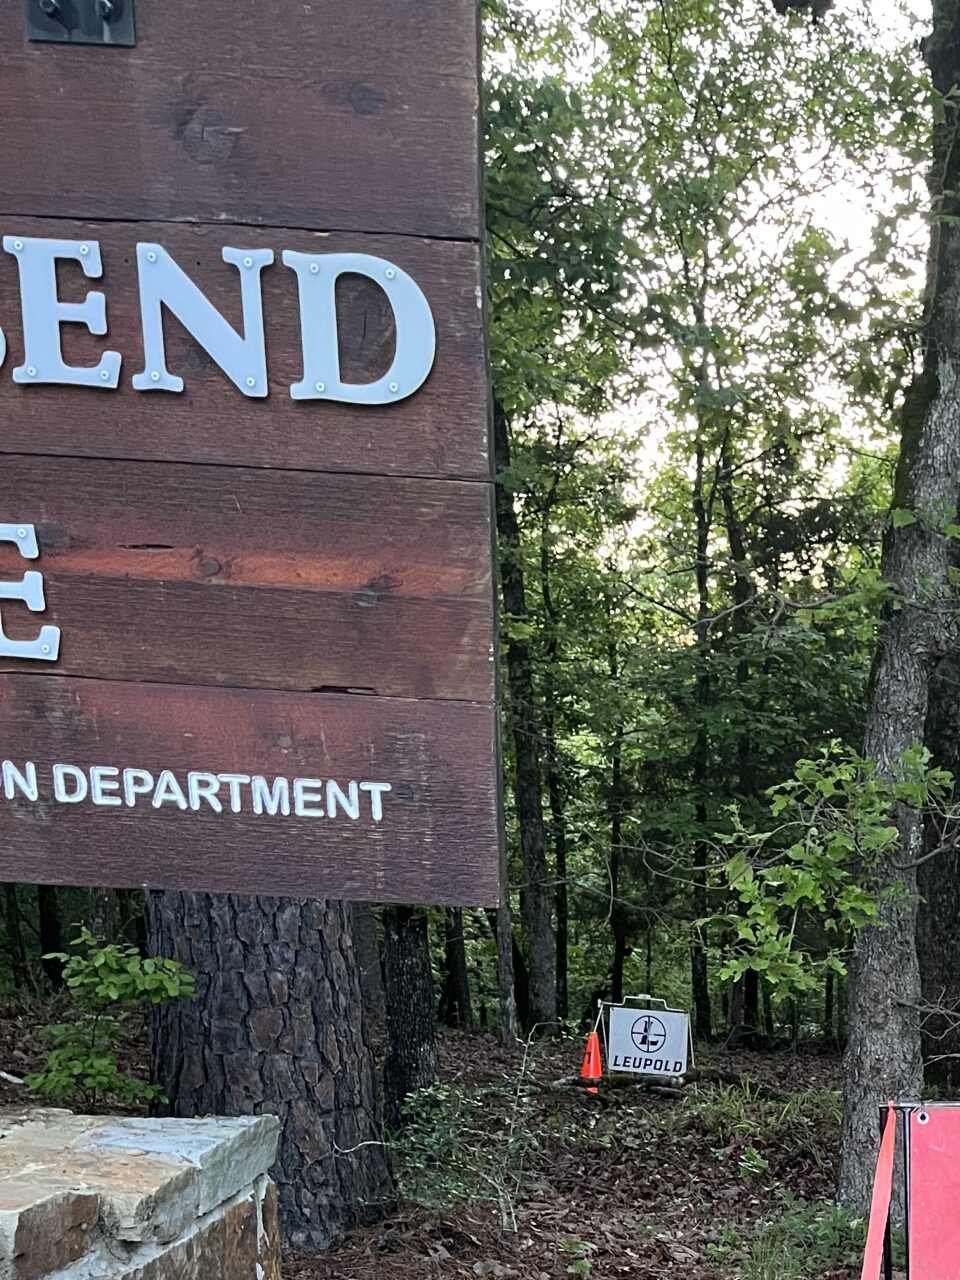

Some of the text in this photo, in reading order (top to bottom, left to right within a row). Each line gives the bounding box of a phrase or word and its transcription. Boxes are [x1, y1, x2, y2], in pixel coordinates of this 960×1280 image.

[0, 235, 436, 405] END
[0, 761, 392, 821] N DEPARTMENT
[613, 1055, 683, 1073] LEUPOLD
